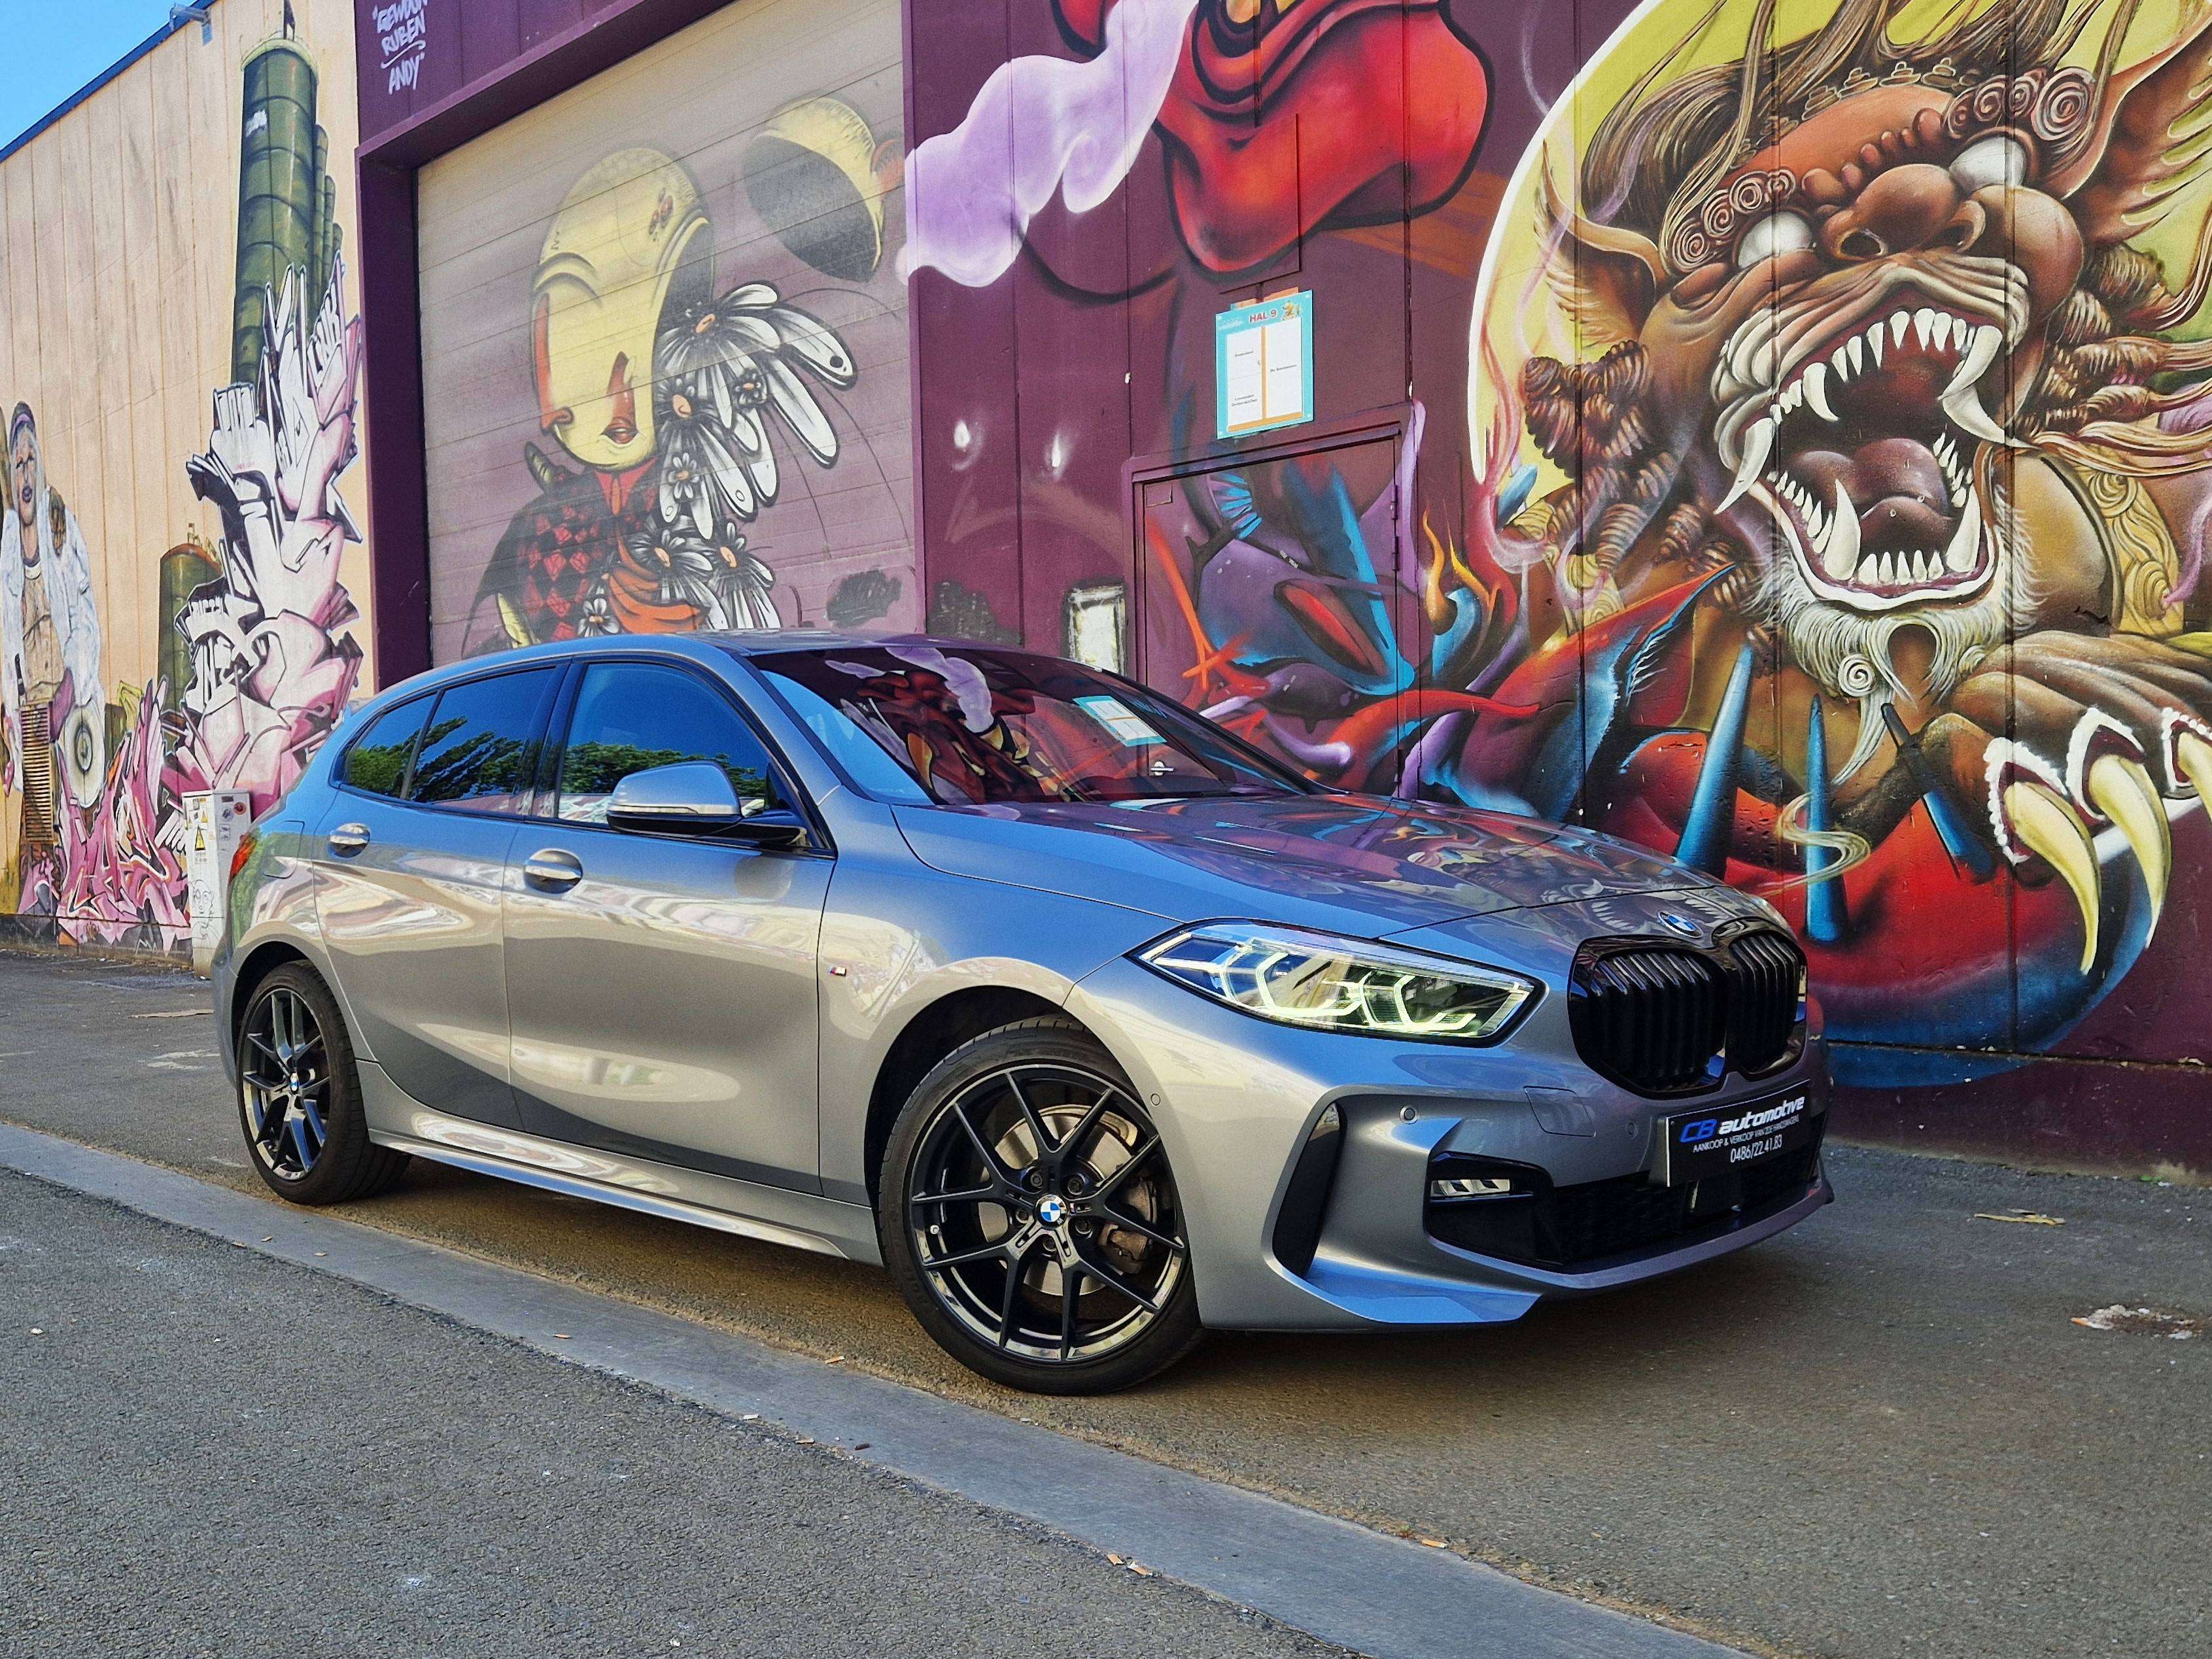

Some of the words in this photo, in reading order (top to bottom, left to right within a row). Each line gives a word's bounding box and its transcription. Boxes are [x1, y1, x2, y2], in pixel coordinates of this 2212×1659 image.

[381, 9, 426, 56] RUBEN
[1250, 313, 1268, 323] HAL
[1680, 1119, 1717, 1143] CB
[1719, 1097, 1805, 1135] automotive
[1693, 1138, 1723, 1153] AANKOOP
